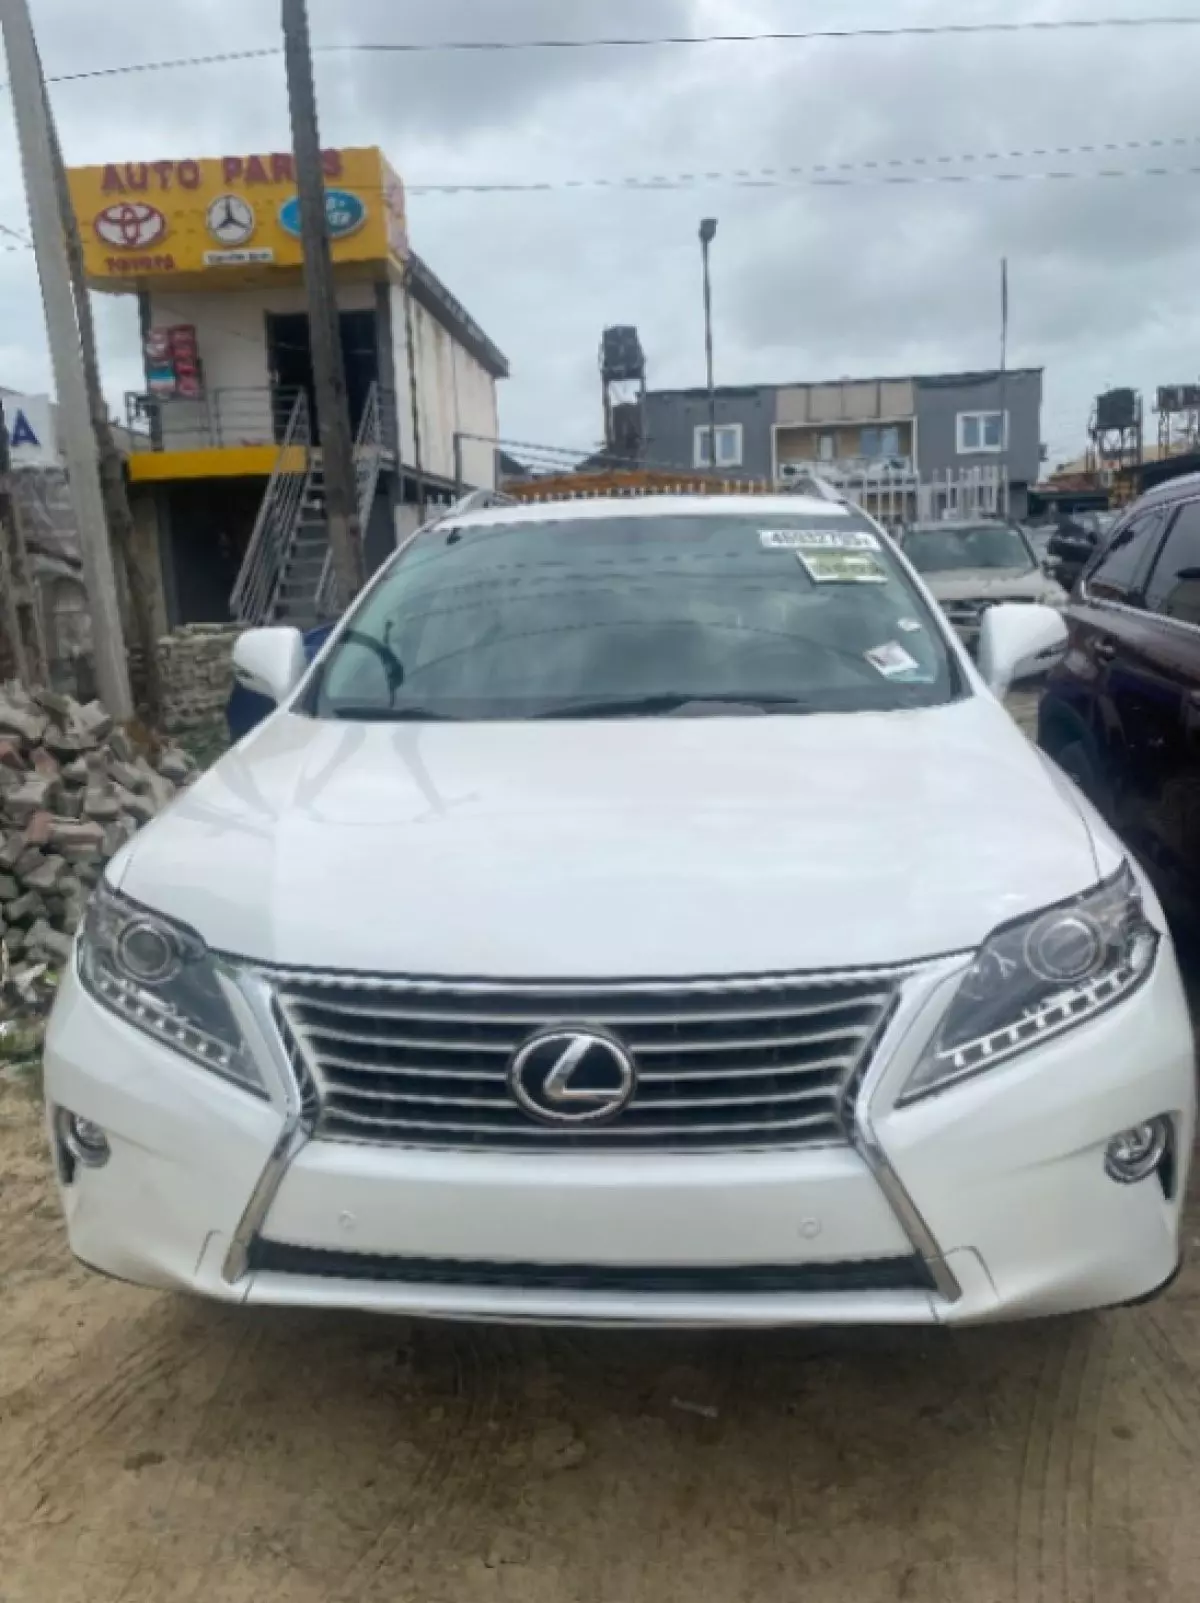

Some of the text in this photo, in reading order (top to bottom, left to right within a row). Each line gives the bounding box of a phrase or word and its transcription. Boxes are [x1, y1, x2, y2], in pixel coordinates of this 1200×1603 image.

[102, 150, 342, 192] AUTO PARS
[11, 408, 41, 447] A
